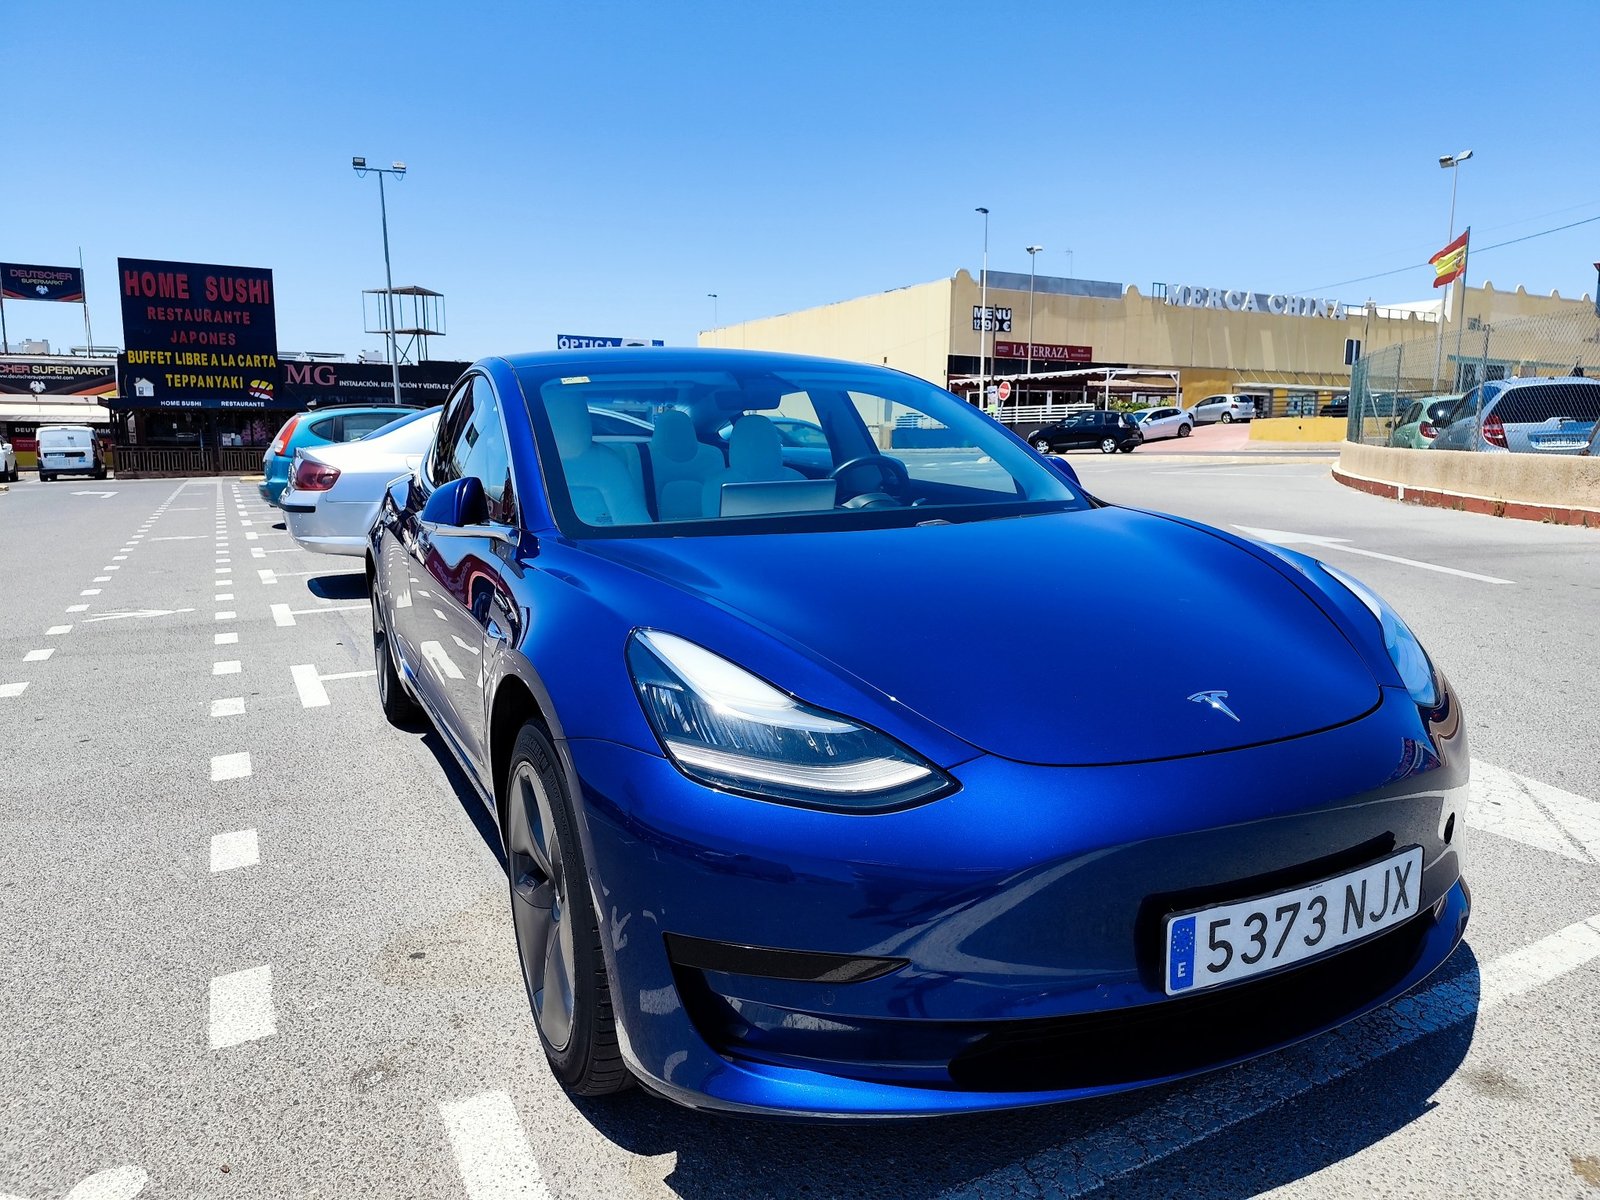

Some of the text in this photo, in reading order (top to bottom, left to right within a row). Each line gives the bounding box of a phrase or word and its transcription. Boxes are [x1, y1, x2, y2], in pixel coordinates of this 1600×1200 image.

[10, 269, 73, 281] DEUTSCHER
[21, 278, 64, 286] SUPERMARKT
[124, 270, 270, 304] HOME SUSHI
[1164, 284, 1348, 320] MERCA CHINA
[147, 306, 251, 325] RESTAURANTE
[170, 329, 236, 346] JAPONES
[127, 350, 276, 368] BUFFET LIBRE A LA CARTA
[1012, 344, 1069, 359] LA TERRAZA
[32, 365, 110, 376] SUPERMARKT
[284, 363, 337, 386] MG
[165, 374, 244, 389] TEPPANYAKI
[1206, 860, 1413, 973] 5373 NJX
[1177, 962, 1187, 978] E
